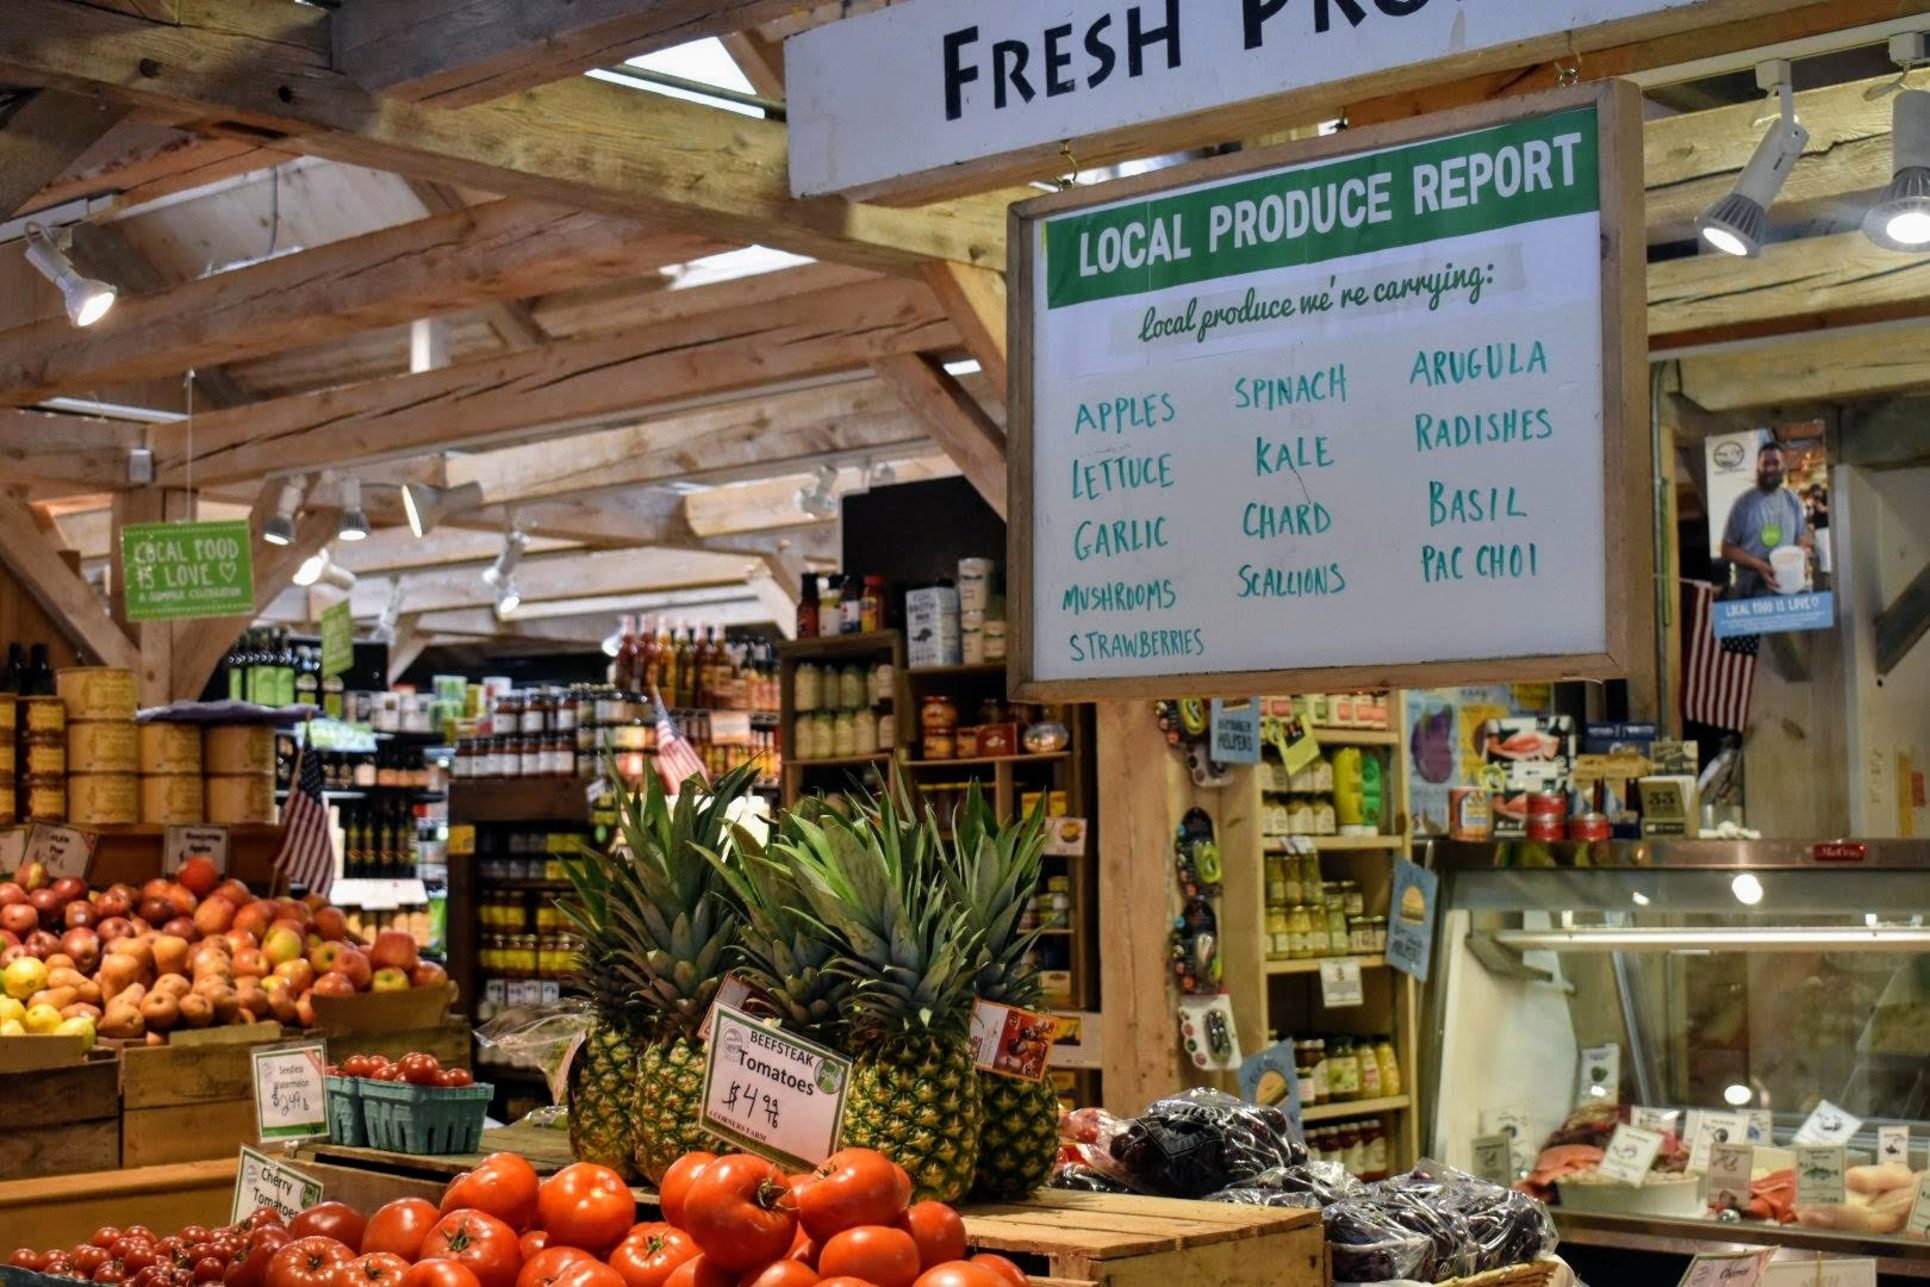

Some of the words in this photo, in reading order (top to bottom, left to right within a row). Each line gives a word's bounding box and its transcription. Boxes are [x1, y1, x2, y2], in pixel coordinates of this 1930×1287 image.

[943, 0, 1181, 121] FRESH
[1080, 213, 1192, 277] LOCAL
[1208, 171, 1393, 253] PRODUCE
[1413, 131, 1583, 215] REPORT
[1138, 297, 1196, 343] local
[1198, 286, 1296, 343] produce
[1300, 274, 1370, 315] we're
[1373, 262, 1495, 312] carrying:
[1410, 339, 1550, 387] ARUGULA
[1233, 363, 1349, 411] SPINACH
[1074, 392, 1176, 434] APPLES
[1414, 407, 1553, 451] RADISHES
[1254, 435, 1335, 476] KALE
[1071, 453, 1174, 501] LETTUCE
[1242, 500, 1333, 539] CHARD
[1428, 479, 1528, 527] BASIL
[194, 538, 239, 561] FOOD
[1073, 516, 1169, 561] GARLIC
[164, 562, 215, 588] LOVE
[1237, 562, 1347, 599] SCALLIONS
[1421, 545, 1465, 583] PAC
[1474, 541, 1540, 579] CHOI
[1062, 579, 1178, 614] MUSHROOMS
[1070, 628, 1205, 662] STRAWBERRIES
[750, 1030, 815, 1067] BEEFSTEAK
[738, 1050, 815, 1096] Tomatoes
[261, 1167, 293, 1196] Cherry
